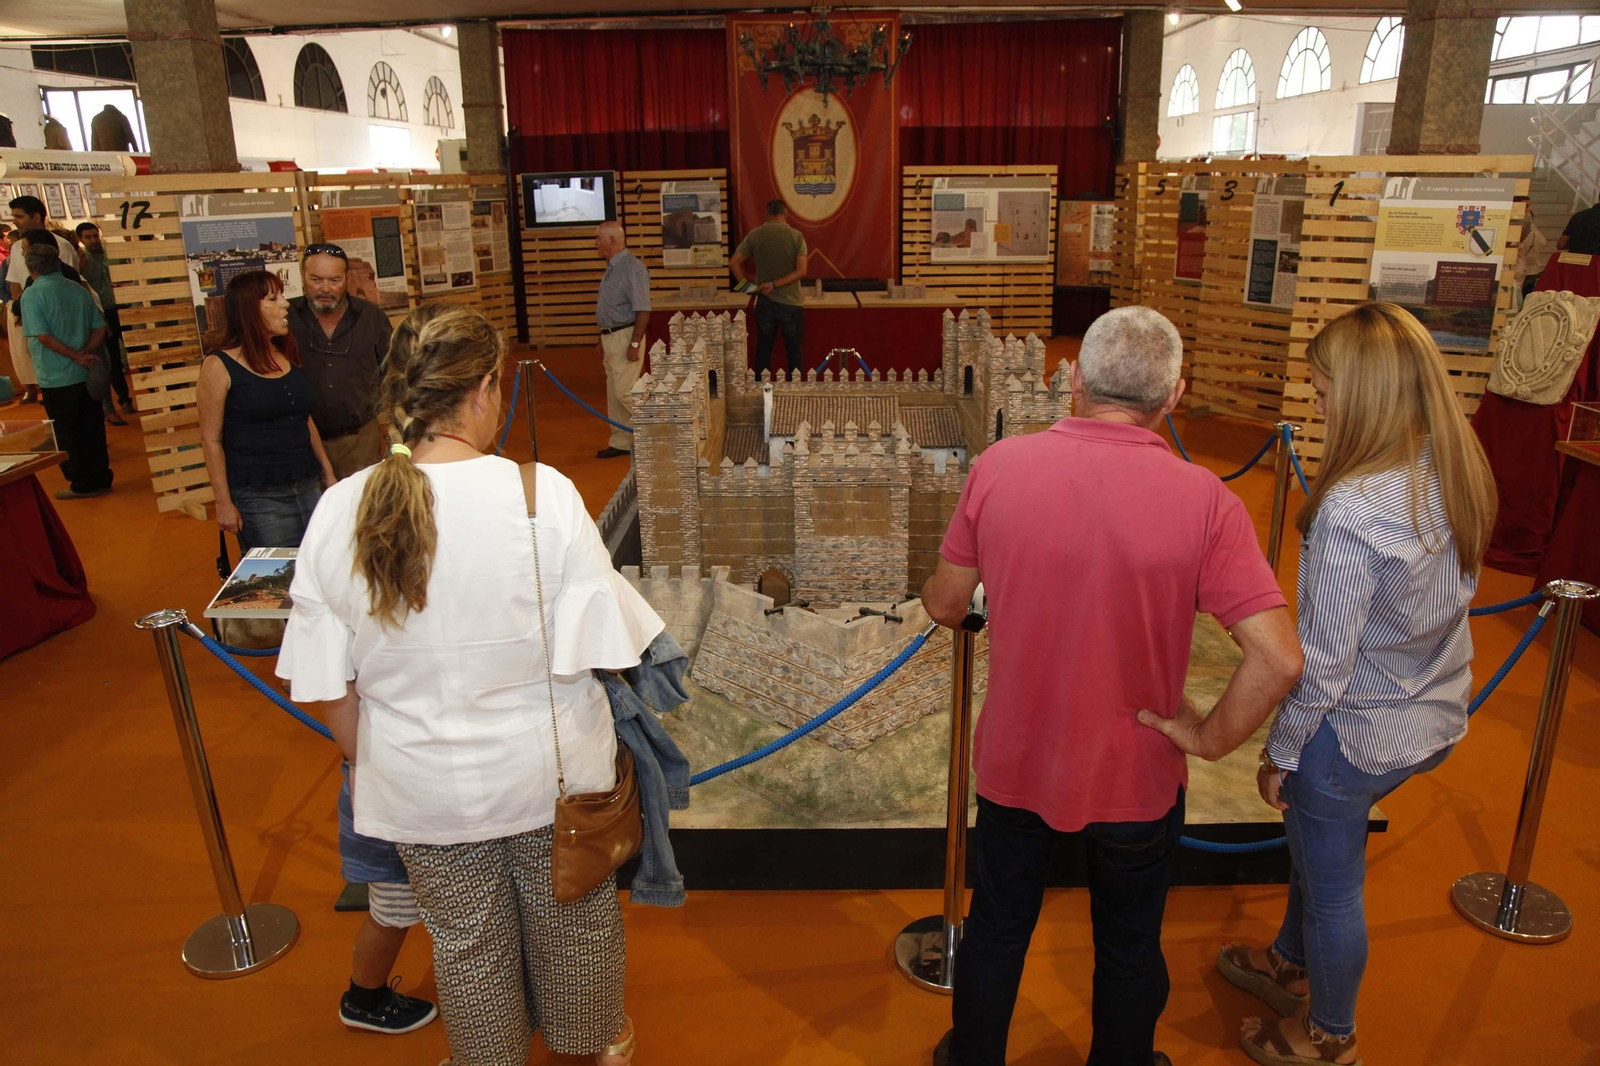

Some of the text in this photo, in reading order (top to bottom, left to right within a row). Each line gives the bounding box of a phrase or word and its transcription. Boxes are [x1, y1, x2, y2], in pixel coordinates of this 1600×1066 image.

[18, 161, 111, 172] JAMONES Y EMBUTIDOS LUIS ARRAYAS
[914, 178, 924, 195] 8
[1155, 179, 1167, 196] 5
[1220, 180, 1238, 201] 3
[1329, 181, 1344, 207] 1
[119, 200, 153, 230] 17
